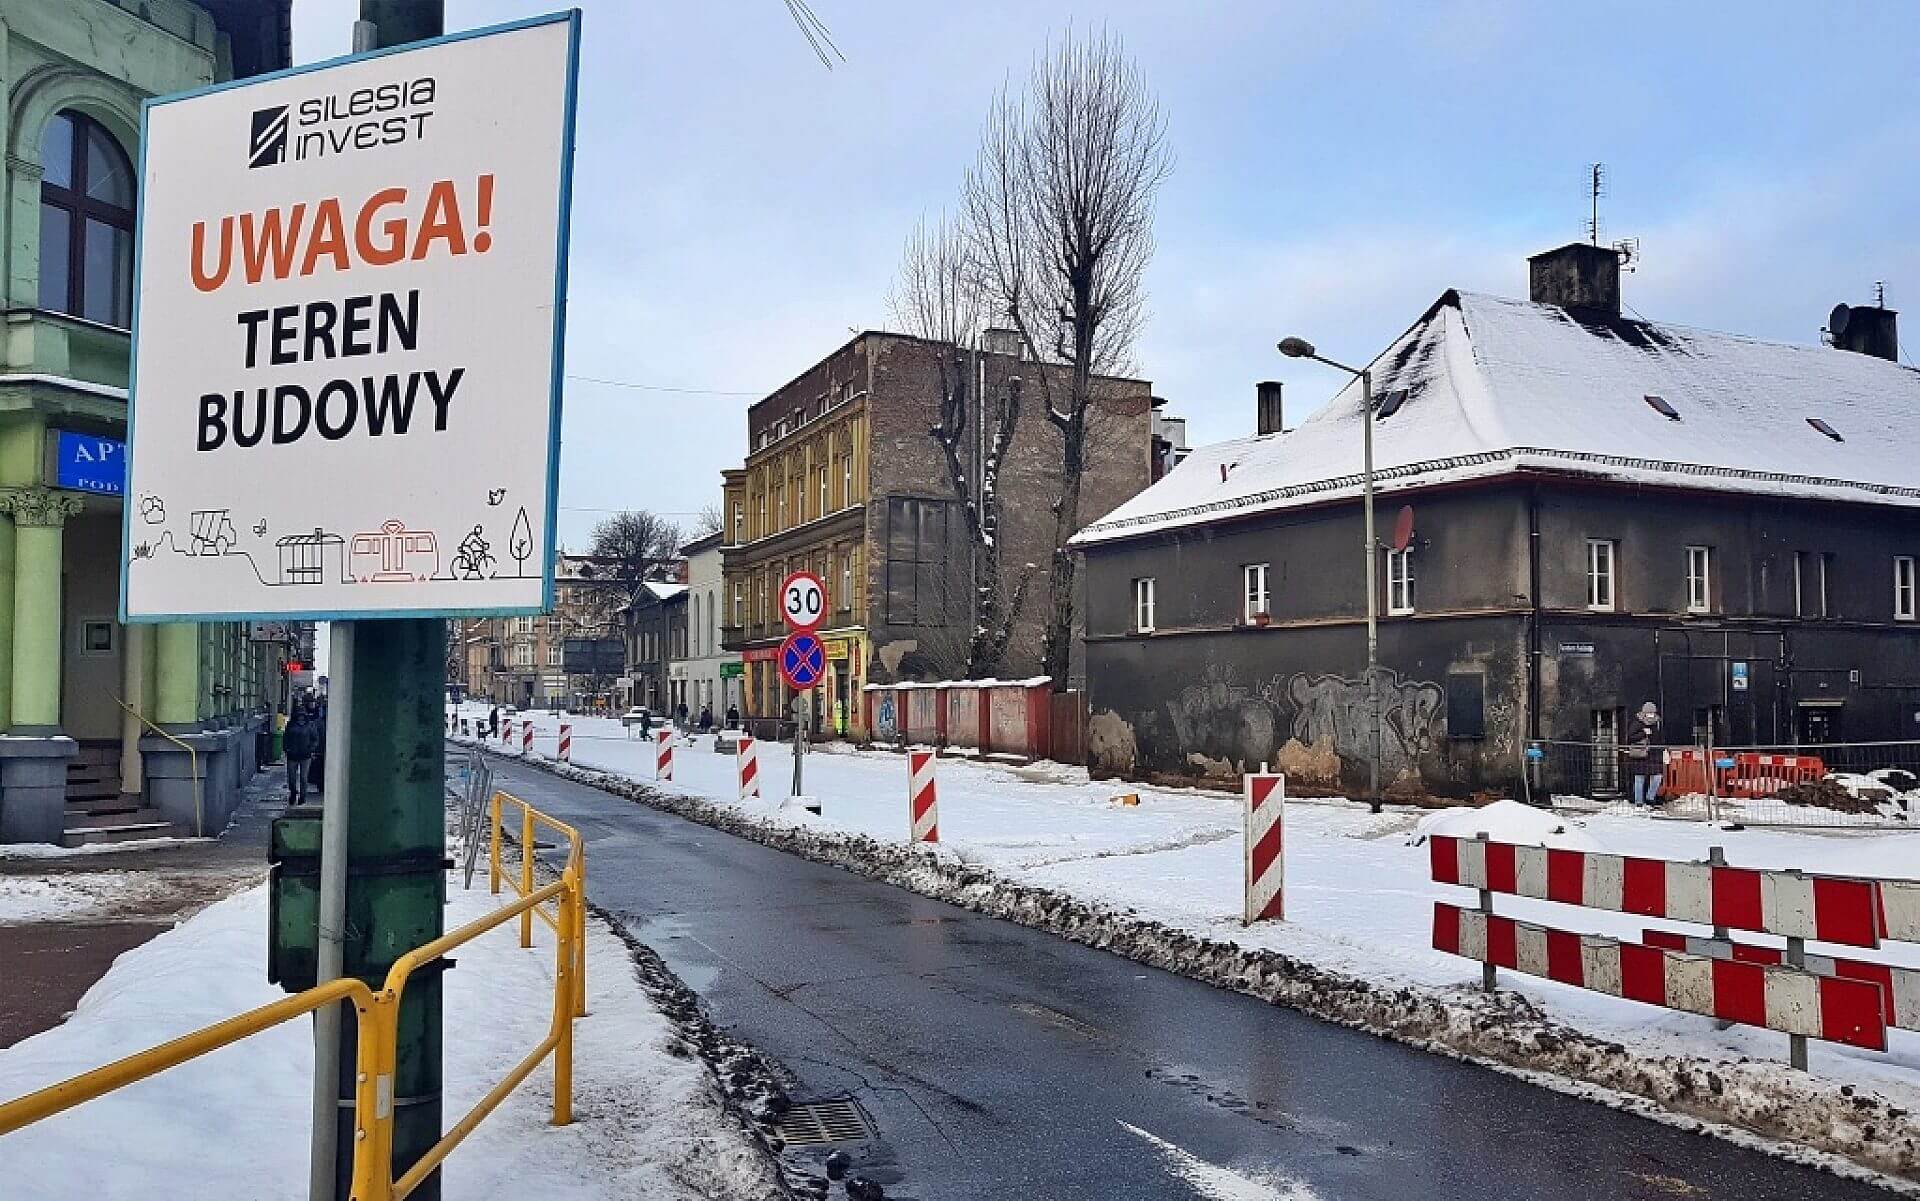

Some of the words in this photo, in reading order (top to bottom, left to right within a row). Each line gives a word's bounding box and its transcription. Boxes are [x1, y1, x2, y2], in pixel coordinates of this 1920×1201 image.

[190, 175, 494, 292] UWAGA!
[237, 289, 420, 369] TEREN
[196, 367, 466, 452] BUDOWY
[788, 587, 820, 615] 30
